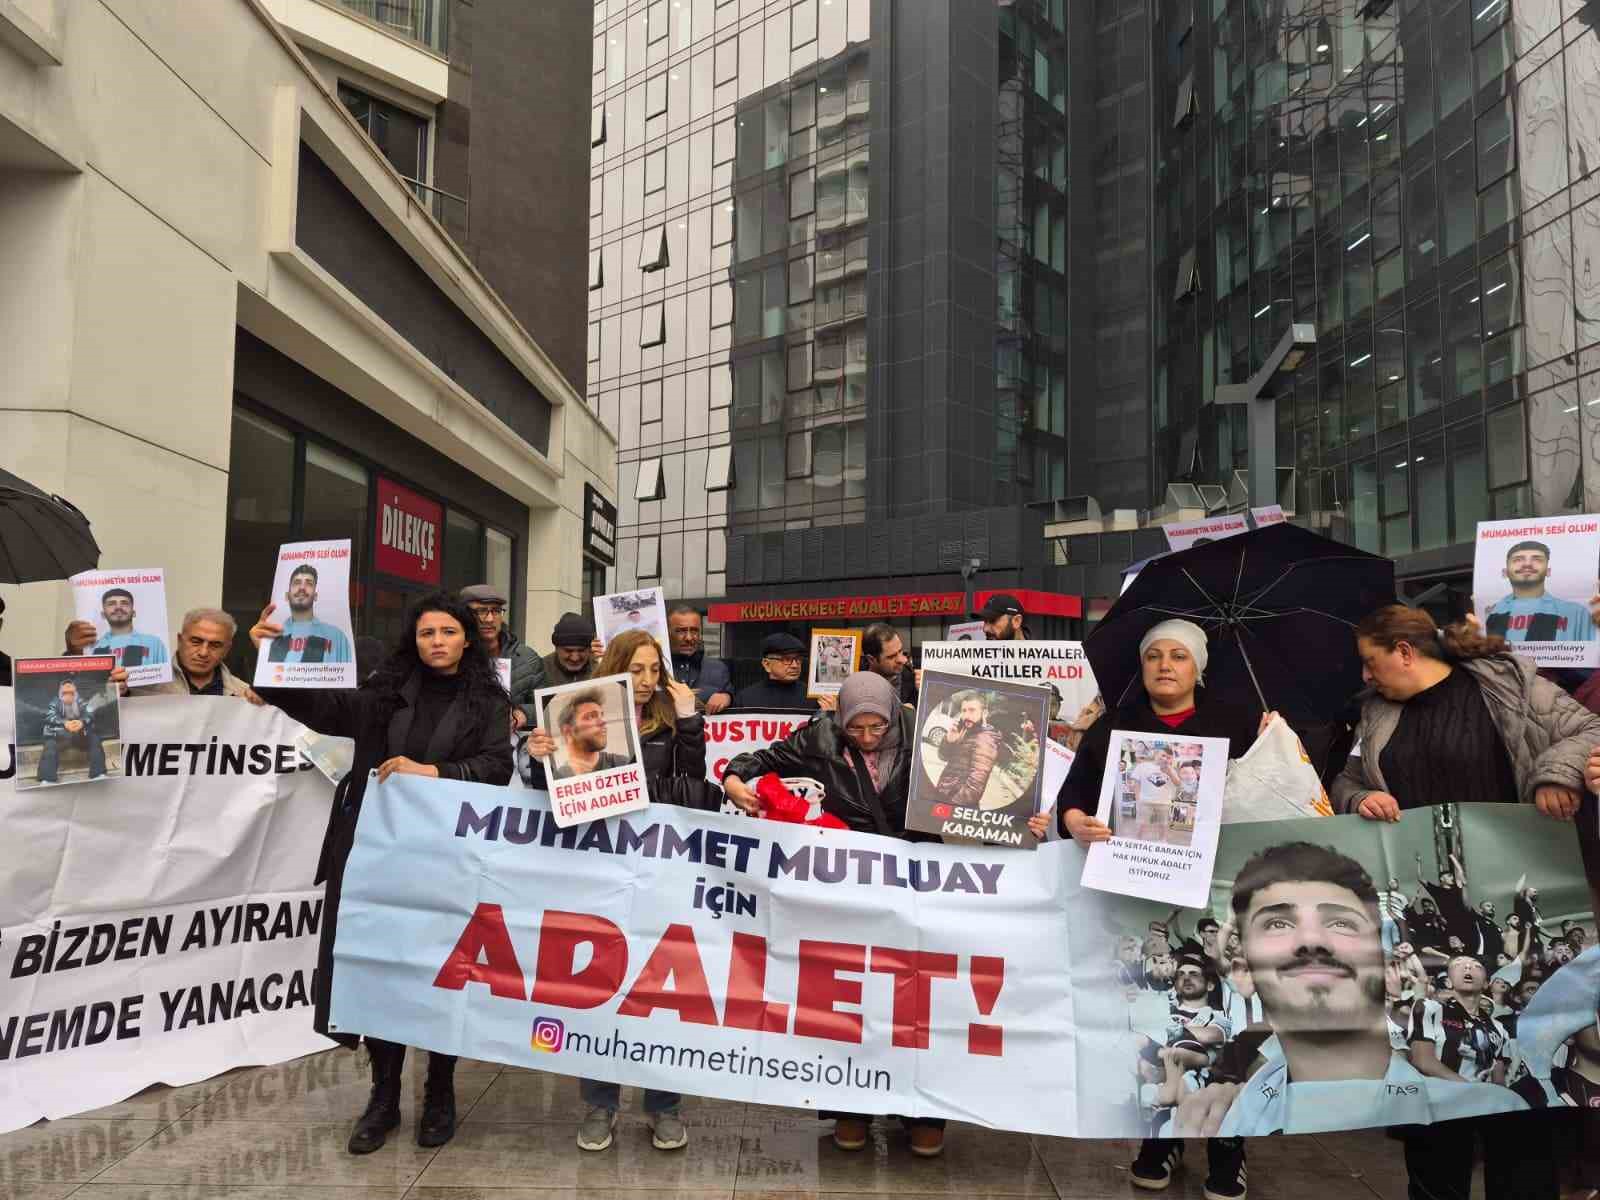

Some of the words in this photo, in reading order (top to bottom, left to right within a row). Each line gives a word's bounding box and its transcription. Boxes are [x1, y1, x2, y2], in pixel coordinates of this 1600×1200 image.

[381, 496, 435, 570] DİLEKÇE
[1481, 526, 1544, 539] MUHAMMETİN
[1545, 524, 1565, 535] SESİ
[740, 602, 845, 619] KÜÇÜKÇEKMECE
[851, 600, 903, 615] ADALET
[924, 645, 1015, 659] MUHAMMET'İN
[1018, 647, 1087, 660] HAYALLER
[972, 663, 1042, 678] KATİLLER
[1047, 665, 1082, 679] ALDI
[556, 780, 592, 799] EREN
[595, 770, 639, 789] ÖZTEK
[559, 799, 587, 817] İÇİN
[590, 788, 640, 809] ADALET
[953, 806, 1015, 828] SELÇUK
[941, 820, 1023, 845] KARAMAN
[455, 801, 760, 874] MUHAMMET
[767, 841, 1005, 895] MUTLUAY
[1155, 846, 1183, 857] BARAN
[1130, 855, 1159, 866] HUKUK
[1161, 860, 1192, 871] ADALET
[10, 914, 174, 978] BİZDEN
[180, 899, 323, 951] AYIRAN
[432, 902, 1005, 1057] ADALET!
[566, 1029, 891, 1091] muhammetinsesiolun
